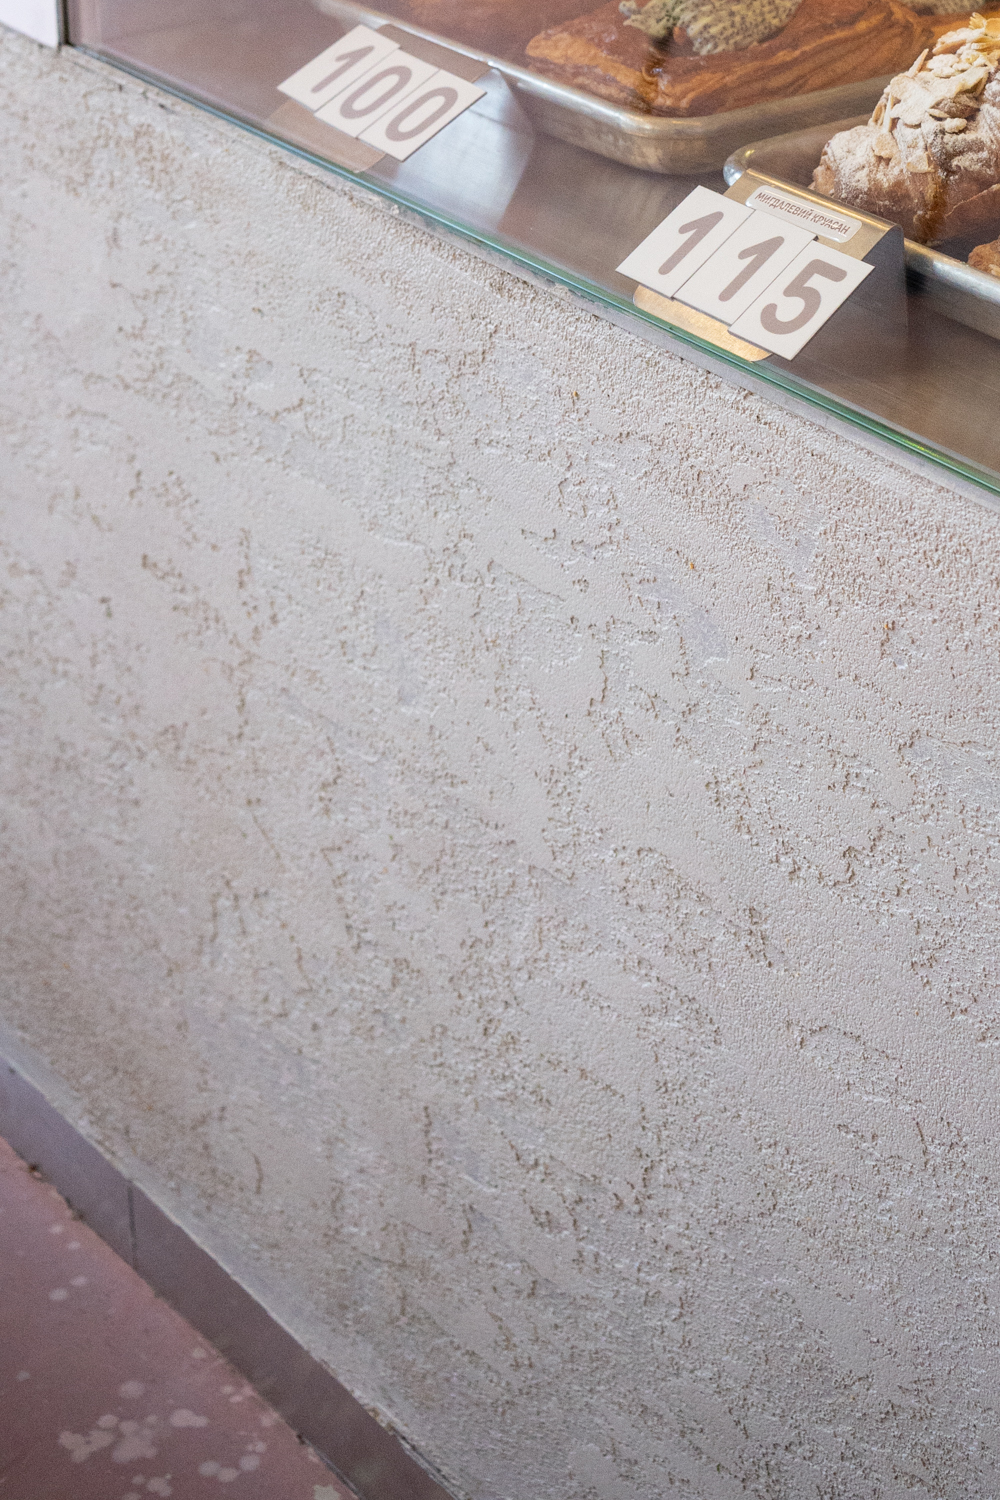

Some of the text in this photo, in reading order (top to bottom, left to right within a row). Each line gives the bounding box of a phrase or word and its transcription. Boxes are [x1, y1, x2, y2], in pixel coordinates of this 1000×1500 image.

[310, 45, 459, 142] 100
[754, 192, 850, 235] МИГДАЛЕВИЙ КРУАСАН
[657, 210, 848, 335] 115
